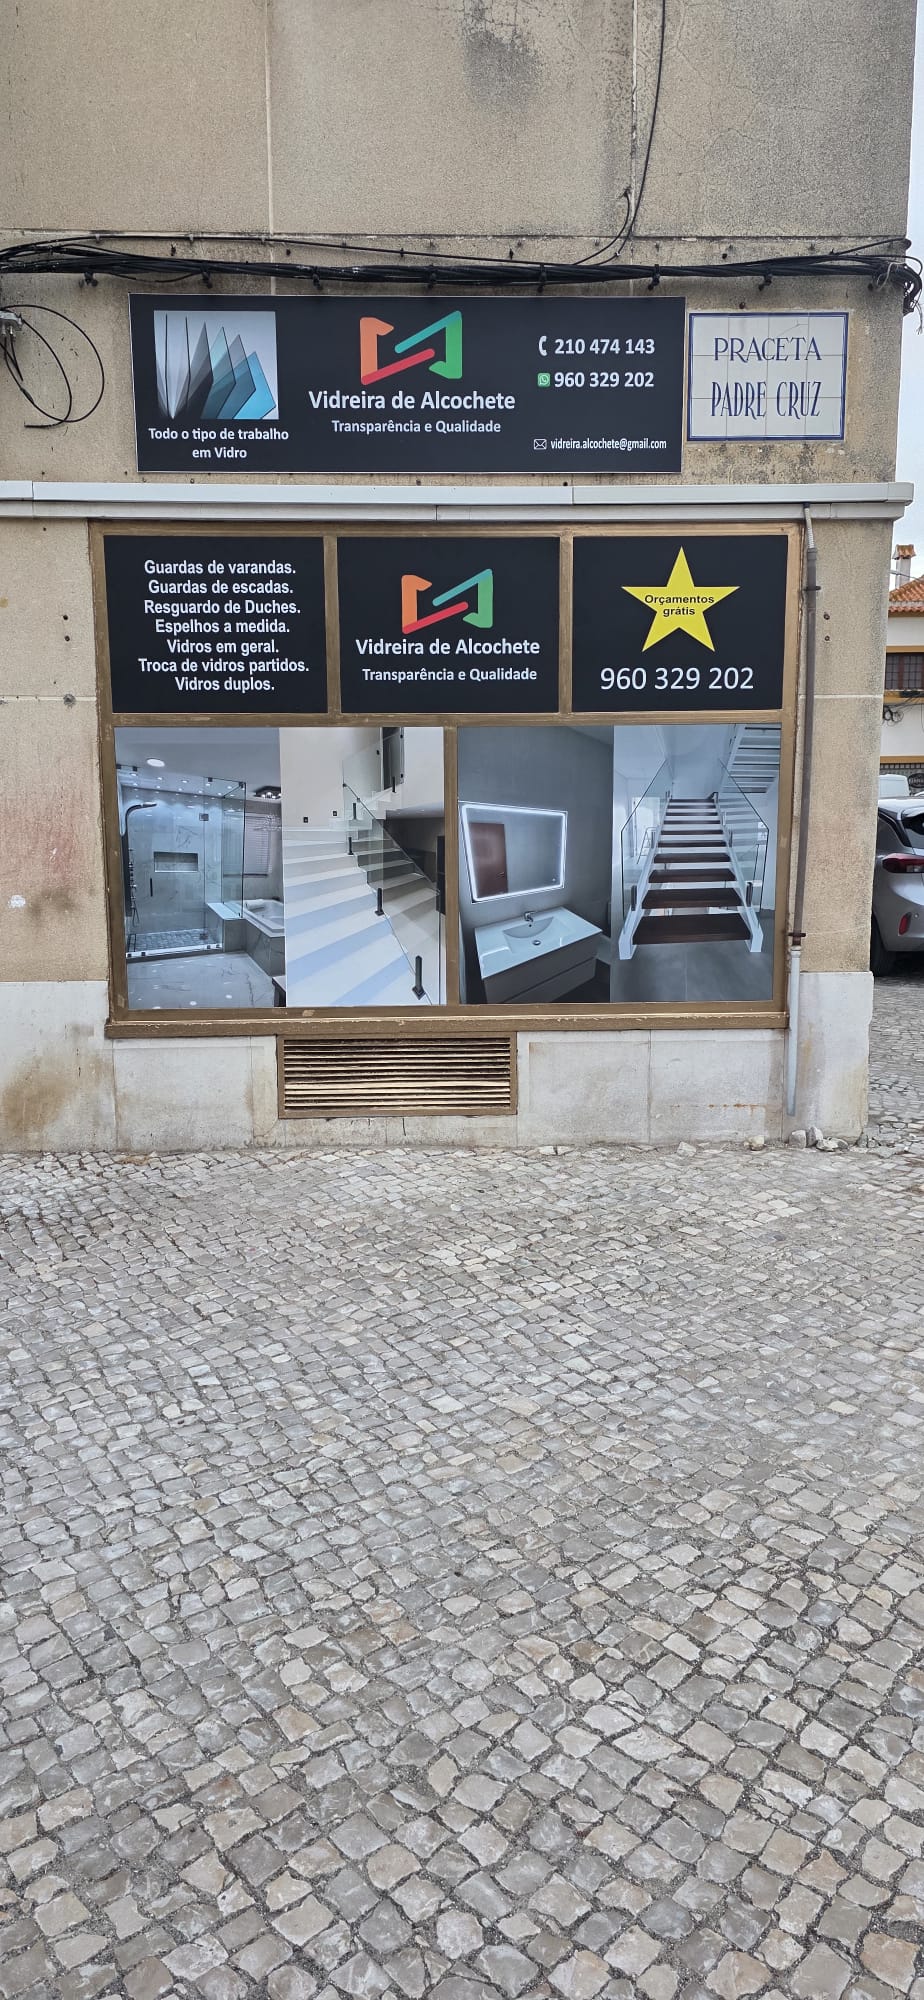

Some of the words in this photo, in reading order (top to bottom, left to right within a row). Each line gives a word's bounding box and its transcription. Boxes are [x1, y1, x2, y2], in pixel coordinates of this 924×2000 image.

[555, 339, 585, 354] 210
[590, 339, 620, 354] 474
[626, 339, 654, 354] 143
[715, 337, 822, 363] PRACETA
[555, 372, 584, 387] 960
[590, 372, 619, 387] 329
[625, 372, 654, 387] 202
[309, 391, 385, 408] Vidreira
[392, 391, 415, 409] de
[421, 391, 515, 409] Alcochete
[712, 382, 766, 420] PADRE
[777, 381, 821, 419] CRUZ
[332, 420, 420, 434] Transparência
[425, 423, 432, 432] e
[436, 420, 500, 433] Qualidade
[149, 428, 178, 439] Todo
[182, 431, 189, 439] o
[192, 428, 216, 442] tipo
[220, 428, 234, 439] de
[238, 428, 288, 439] trabalho
[551, 438, 666, 451] vidreira.alcochete@gmail.com
[215, 447, 247, 458] Vidro
[145, 560, 203, 573] Guardas
[208, 560, 224, 573] de
[228, 560, 295, 573] varandas.
[149, 580, 207, 593] Guardas
[212, 580, 228, 593] de
[233, 580, 293, 593] escadas.
[645, 595, 715, 606] Orçamentos
[145, 600, 219, 617] Resguardo
[224, 600, 240, 613] de
[245, 600, 300, 613] Duches.
[663, 606, 695, 617] grátis
[156, 619, 219, 635] Espelhos
[224, 623, 231, 632] a
[236, 619, 289, 632] medida.
[167, 639, 212, 653] Vidros
[216, 643, 236, 652] em
[241, 639, 279, 656] geral.
[356, 639, 423, 654] Vidreira
[430, 639, 450, 654] de
[456, 638, 539, 654] Alcochete
[138, 658, 177, 671] Troca
[182, 659, 197, 671] de
[202, 658, 245, 671] vidros
[249, 658, 309, 675] partidos.
[362, 668, 454, 683] Transparência
[458, 671, 465, 680] e
[470, 668, 537, 681] Qualidade
[601, 668, 646, 689] 960
[655, 668, 700, 689] 329
[709, 668, 753, 689] 202
[175, 677, 219, 690] Vidros
[224, 677, 274, 693] duplos.
